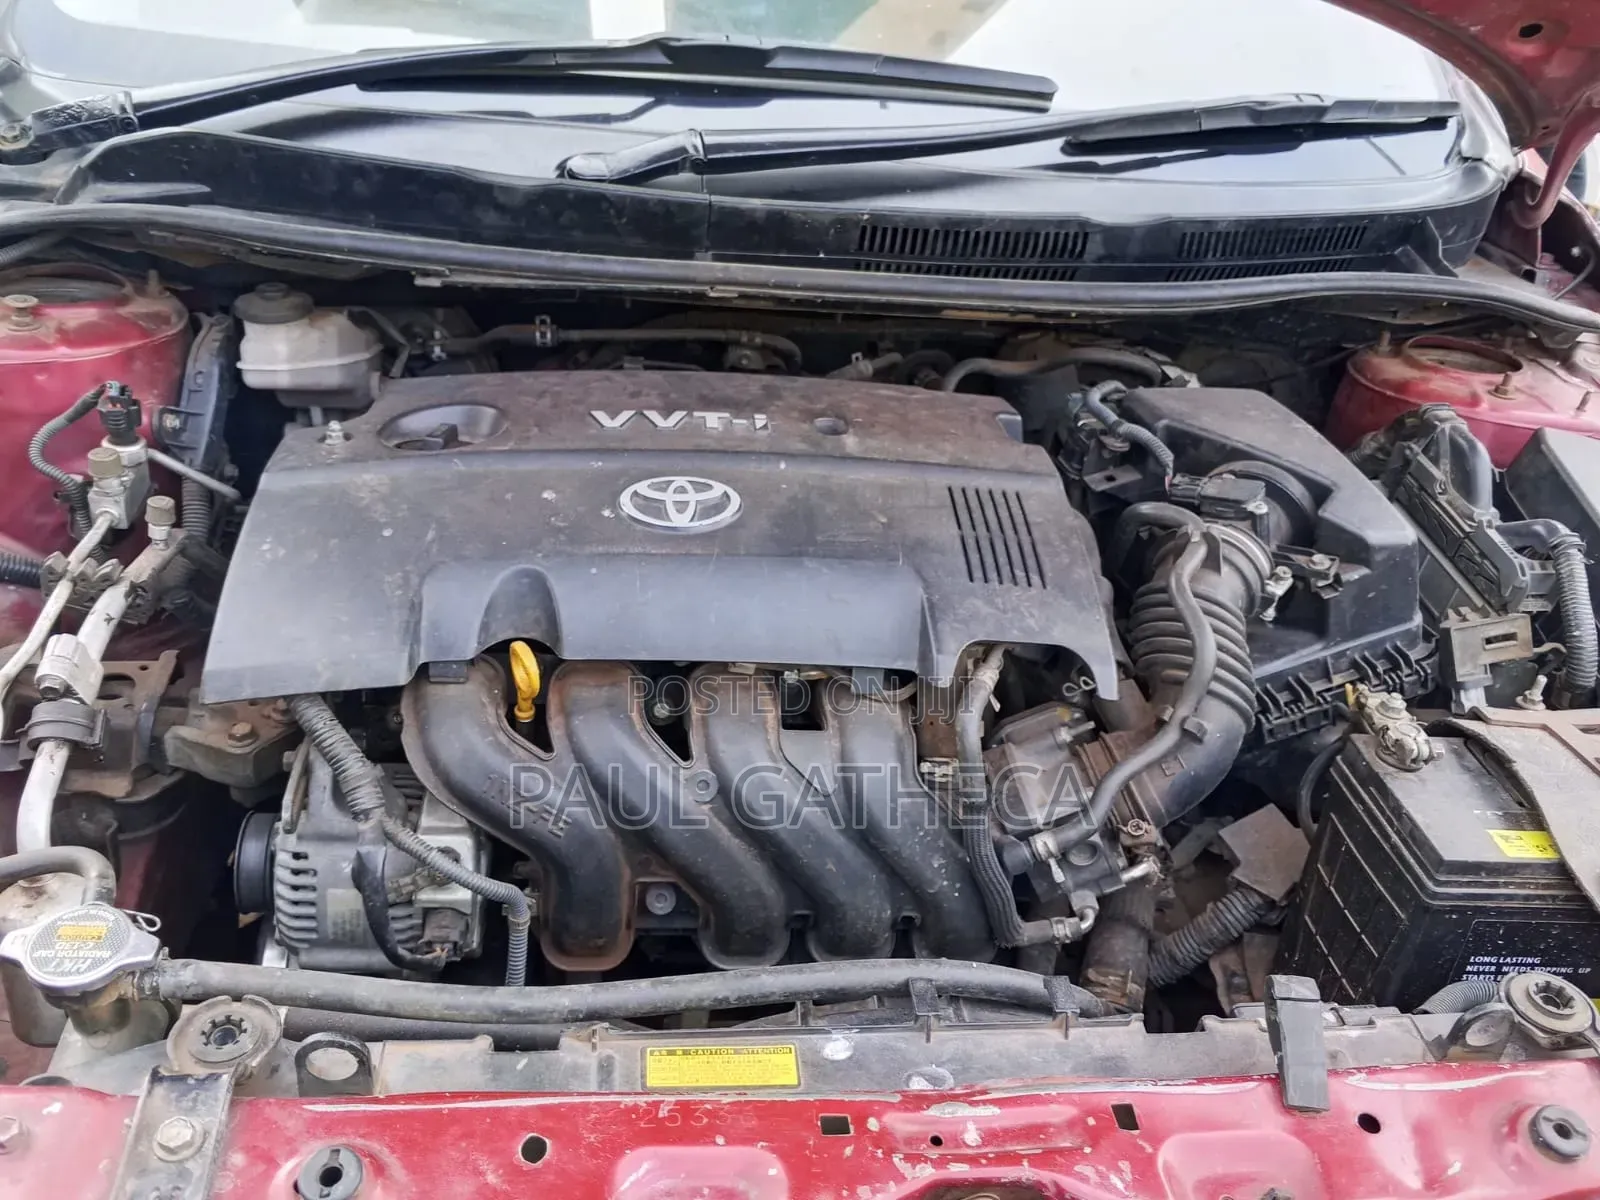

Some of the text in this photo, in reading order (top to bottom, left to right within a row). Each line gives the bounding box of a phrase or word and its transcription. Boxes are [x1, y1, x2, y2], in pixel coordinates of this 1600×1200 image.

[589, 410, 770, 430] VVT-i
[32, 950, 113, 958] RADIATOR CAP
[1499, 956, 1542, 964] LASTING
[1533, 966, 1574, 974] TOPPING
[690, 1048, 734, 1056] CAUTION
[743, 1046, 790, 1055] ATTENTION
